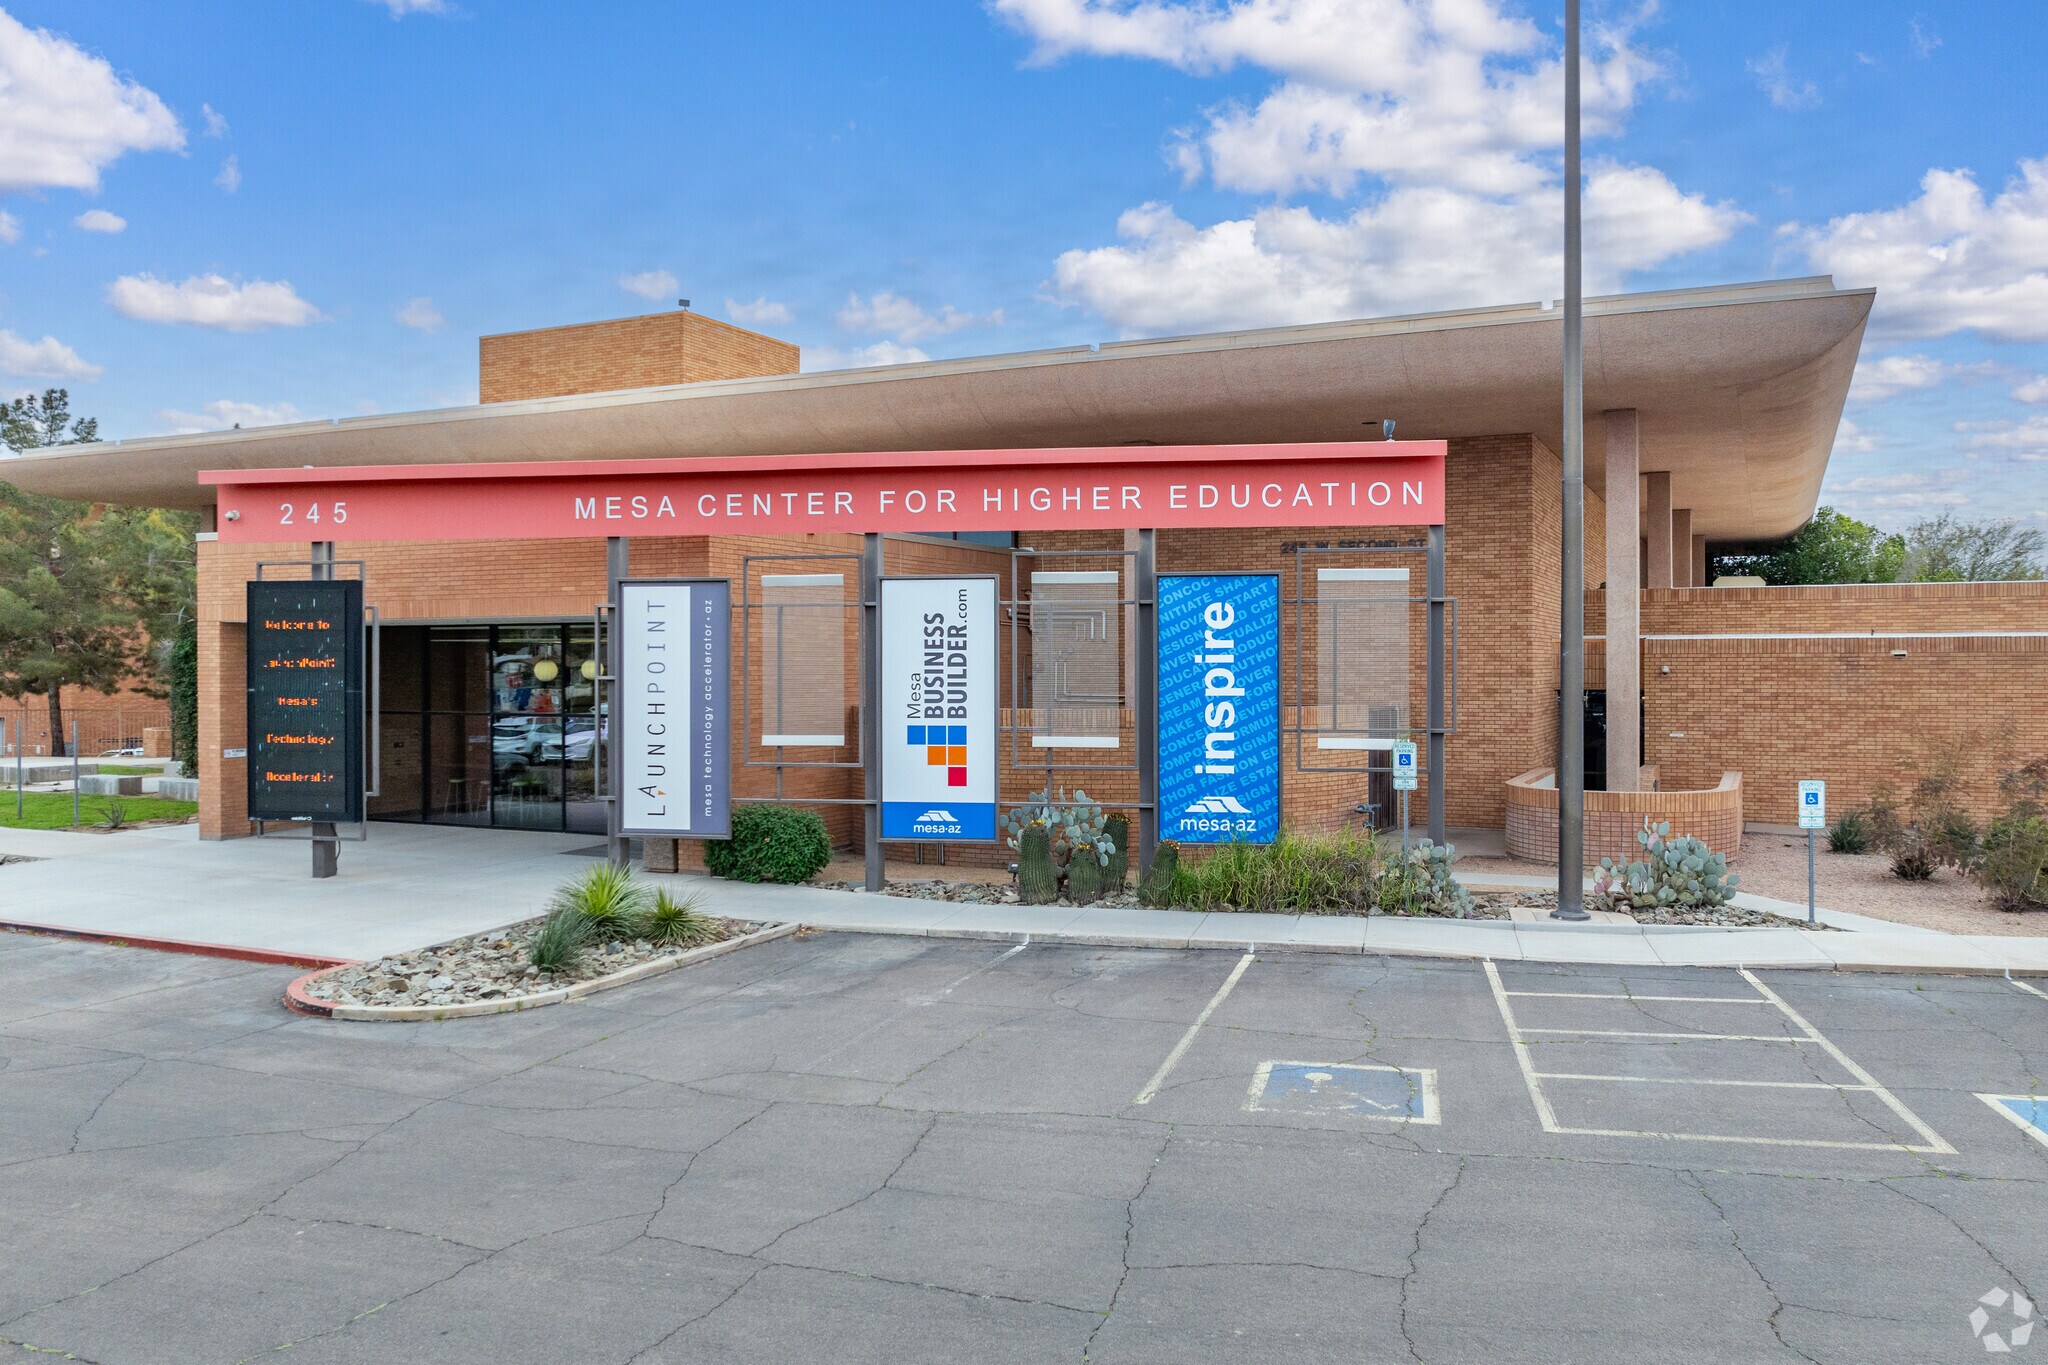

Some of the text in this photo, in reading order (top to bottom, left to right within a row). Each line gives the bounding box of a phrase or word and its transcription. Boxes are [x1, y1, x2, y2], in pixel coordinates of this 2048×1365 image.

[280, 502, 347, 525] 245
[575, 481, 1423, 520] MESA CENTER FOR HIGHER EDUCATION
[638, 600, 666, 816] LAUNCHPOINT
[703, 600, 714, 816] mesa technology accelerator az
[907, 672, 921, 719] Mesa
[924, 612, 945, 719] BUSINESS
[1195, 602, 1245, 774] inspire
